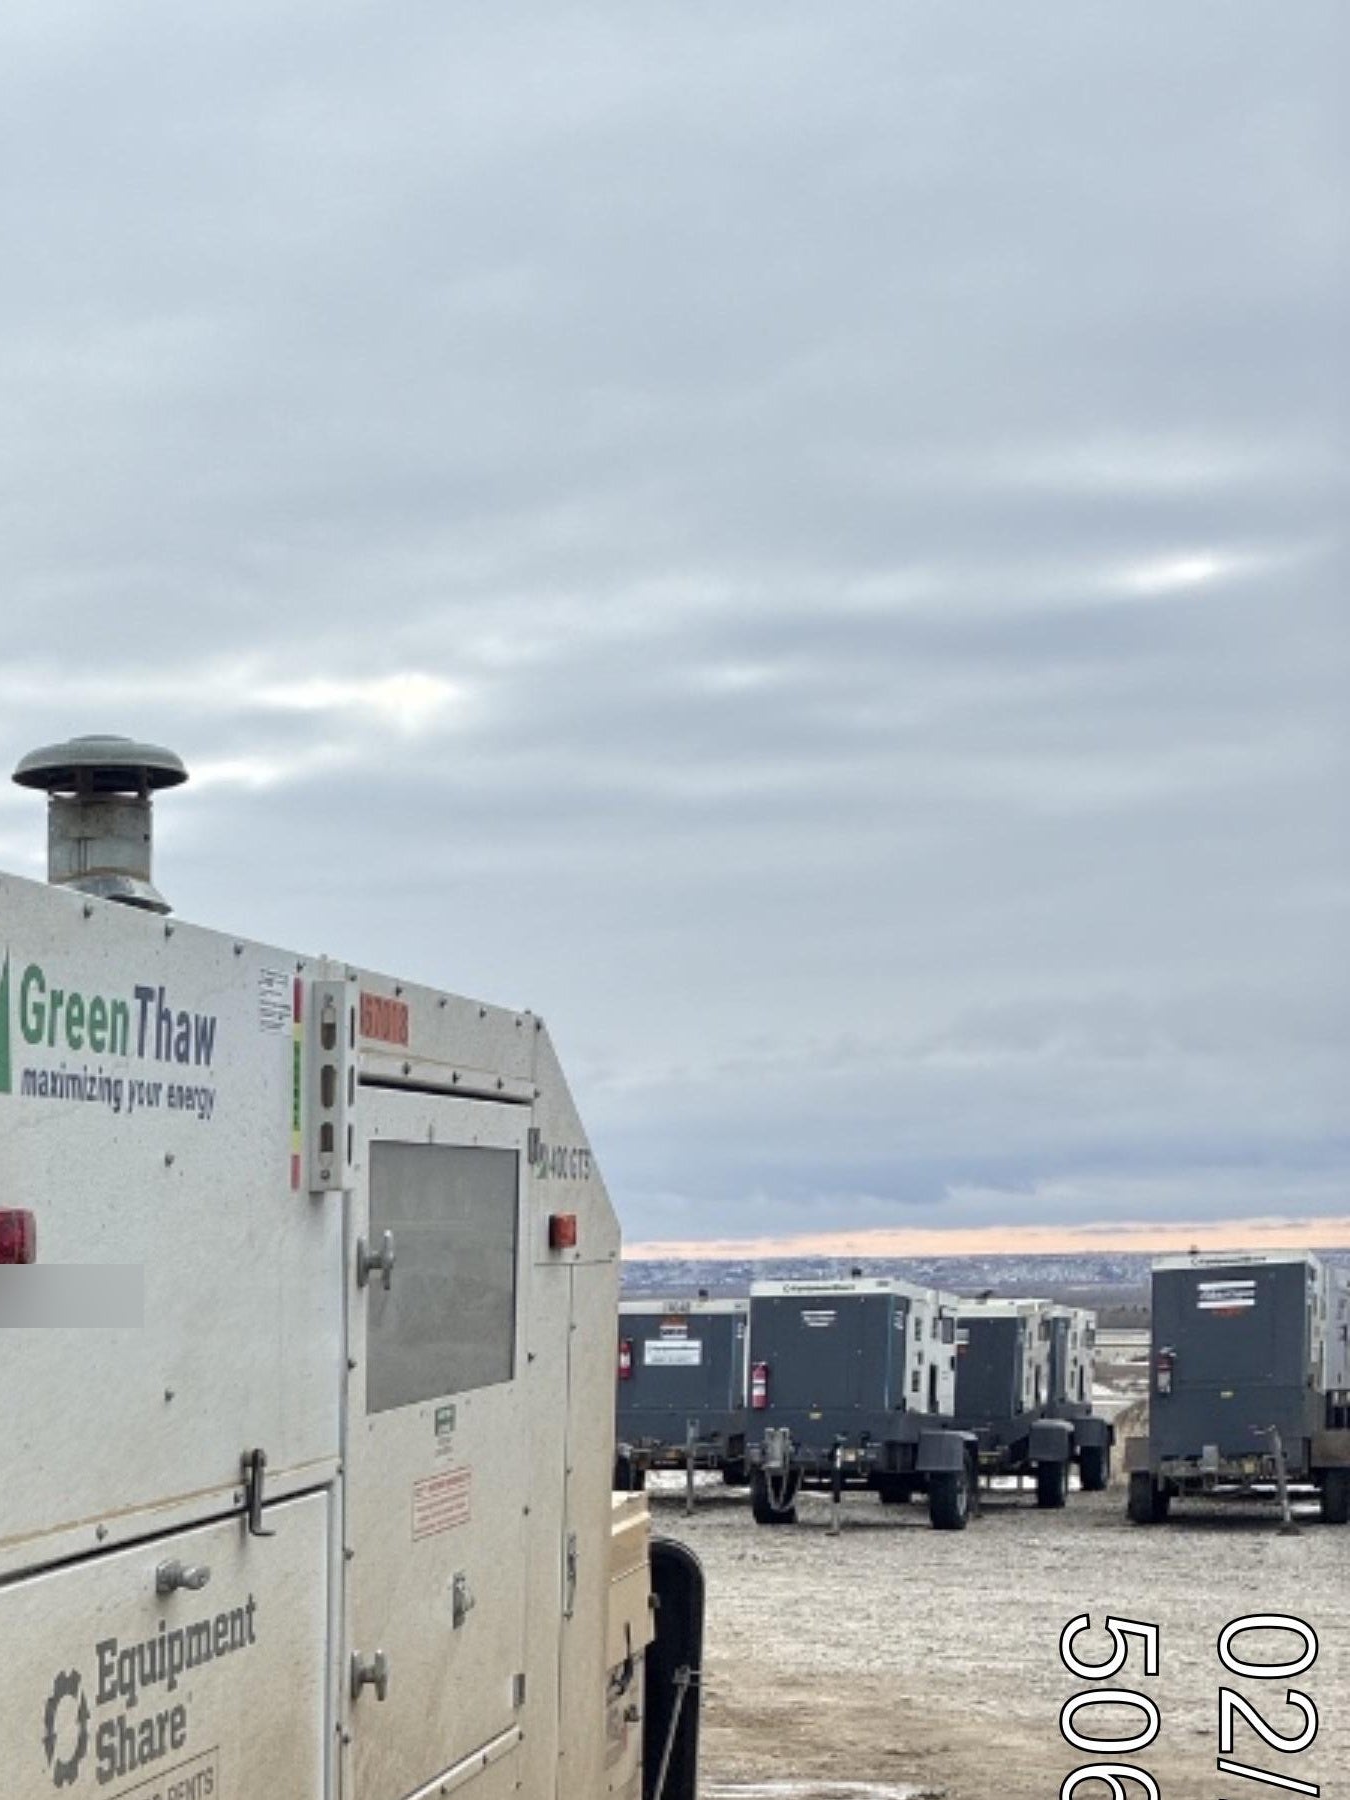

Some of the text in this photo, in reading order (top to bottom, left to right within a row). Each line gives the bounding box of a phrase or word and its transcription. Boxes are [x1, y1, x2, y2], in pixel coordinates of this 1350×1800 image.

[20, 963, 216, 1067] GreenThaw
[21, 1063, 216, 1119] maximizing your energy
[96, 1592, 256, 1709] Equipment
[96, 1702, 187, 1786] Share
